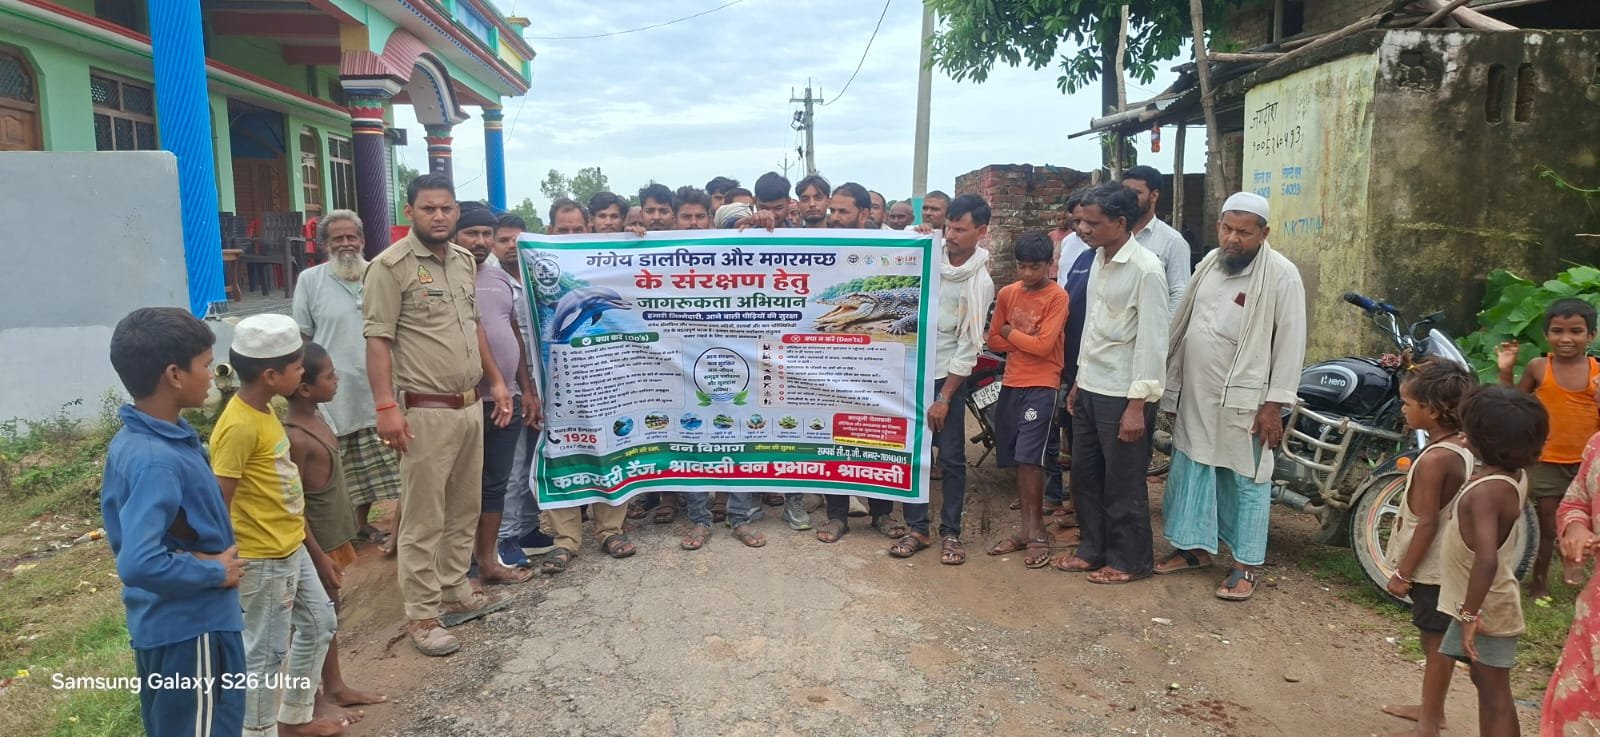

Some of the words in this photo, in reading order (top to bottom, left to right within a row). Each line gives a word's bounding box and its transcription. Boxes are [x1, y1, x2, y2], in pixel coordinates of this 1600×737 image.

[586, 251, 633, 267] गंगेय
[639, 248, 717, 267] डालफिन
[721, 248, 754, 266] और
[759, 252, 837, 267] मगरमच्छ
[634, 269, 663, 290] के
[671, 269, 766, 291] संरक्षण
[773, 269, 810, 295] हेतु
[636, 296, 731, 309] जागरूकता
[737, 293, 807, 309] अभियान
[563, 433, 598, 444] 1926
[669, 443, 694, 453] वन
[697, 442, 746, 453] विभाग
[626, 459, 662, 477] रेंज,
[669, 456, 735, 474] श्रावस्ती
[739, 461, 768, 474] वन
[773, 460, 832, 478] प्रभाग,
[837, 463, 904, 484] श्रावस्ती
